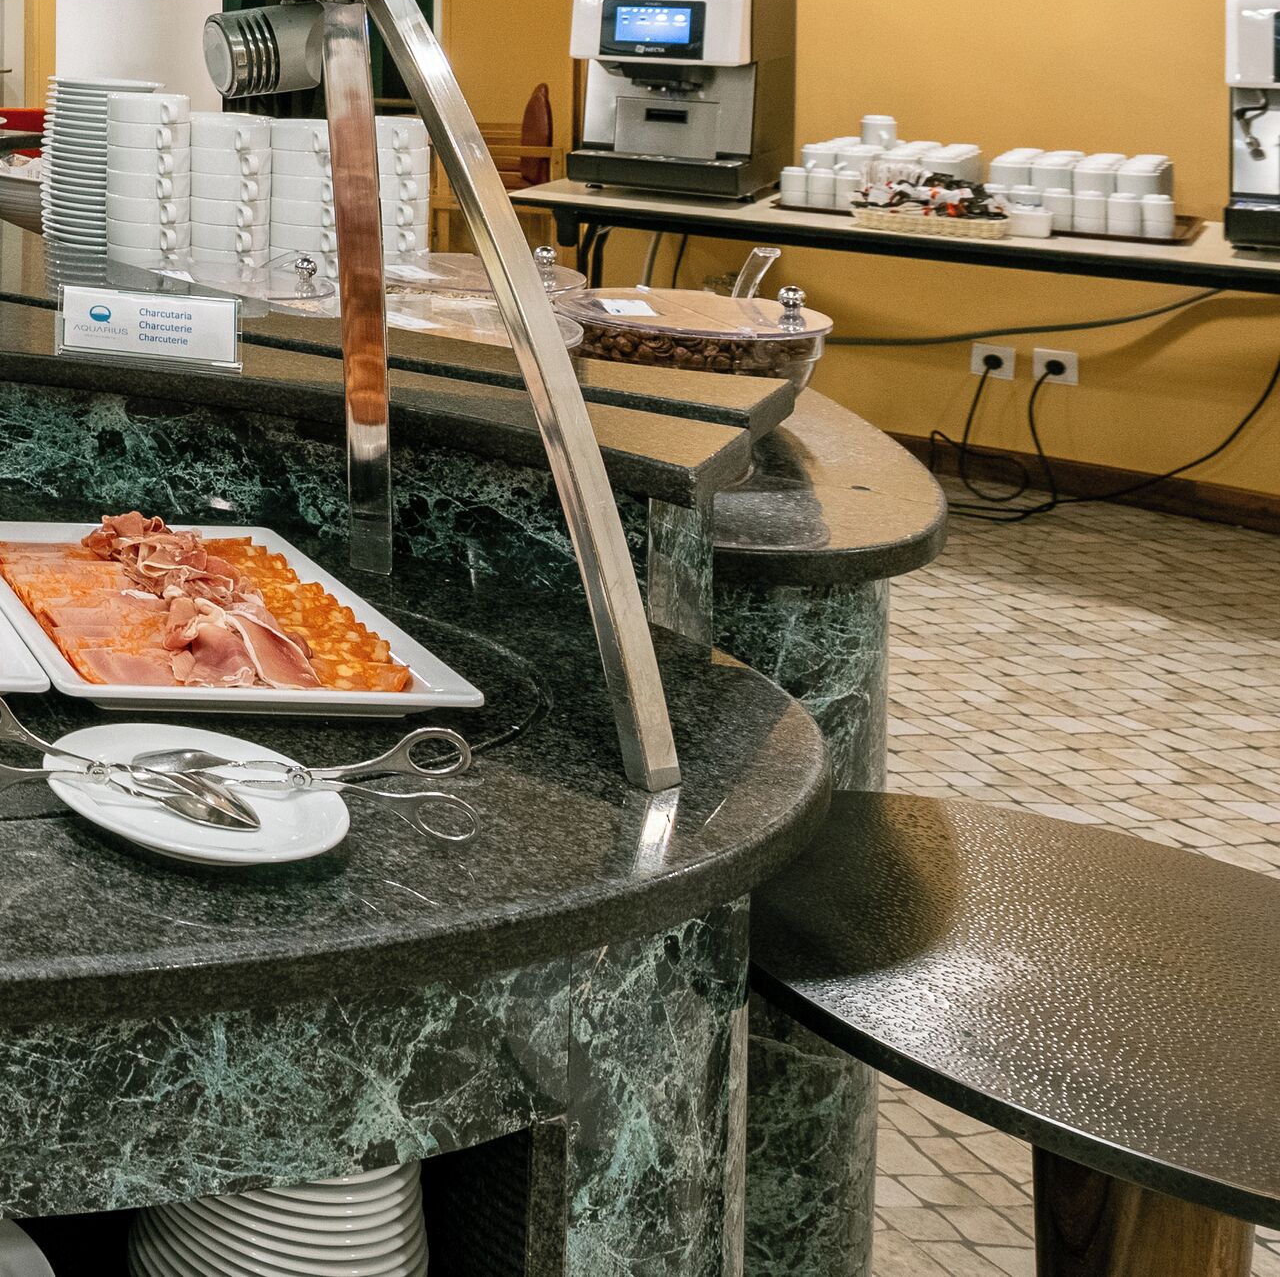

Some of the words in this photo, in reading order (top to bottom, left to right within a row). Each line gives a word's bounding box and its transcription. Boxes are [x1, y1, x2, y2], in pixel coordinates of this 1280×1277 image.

[644, 46, 666, 54] NECTA
[139, 307, 193, 321] Charcutaria
[73, 323, 129, 336] AQUARIUS
[138, 320, 193, 333] Charcuterie
[138, 333, 188, 345] Charcuterie
